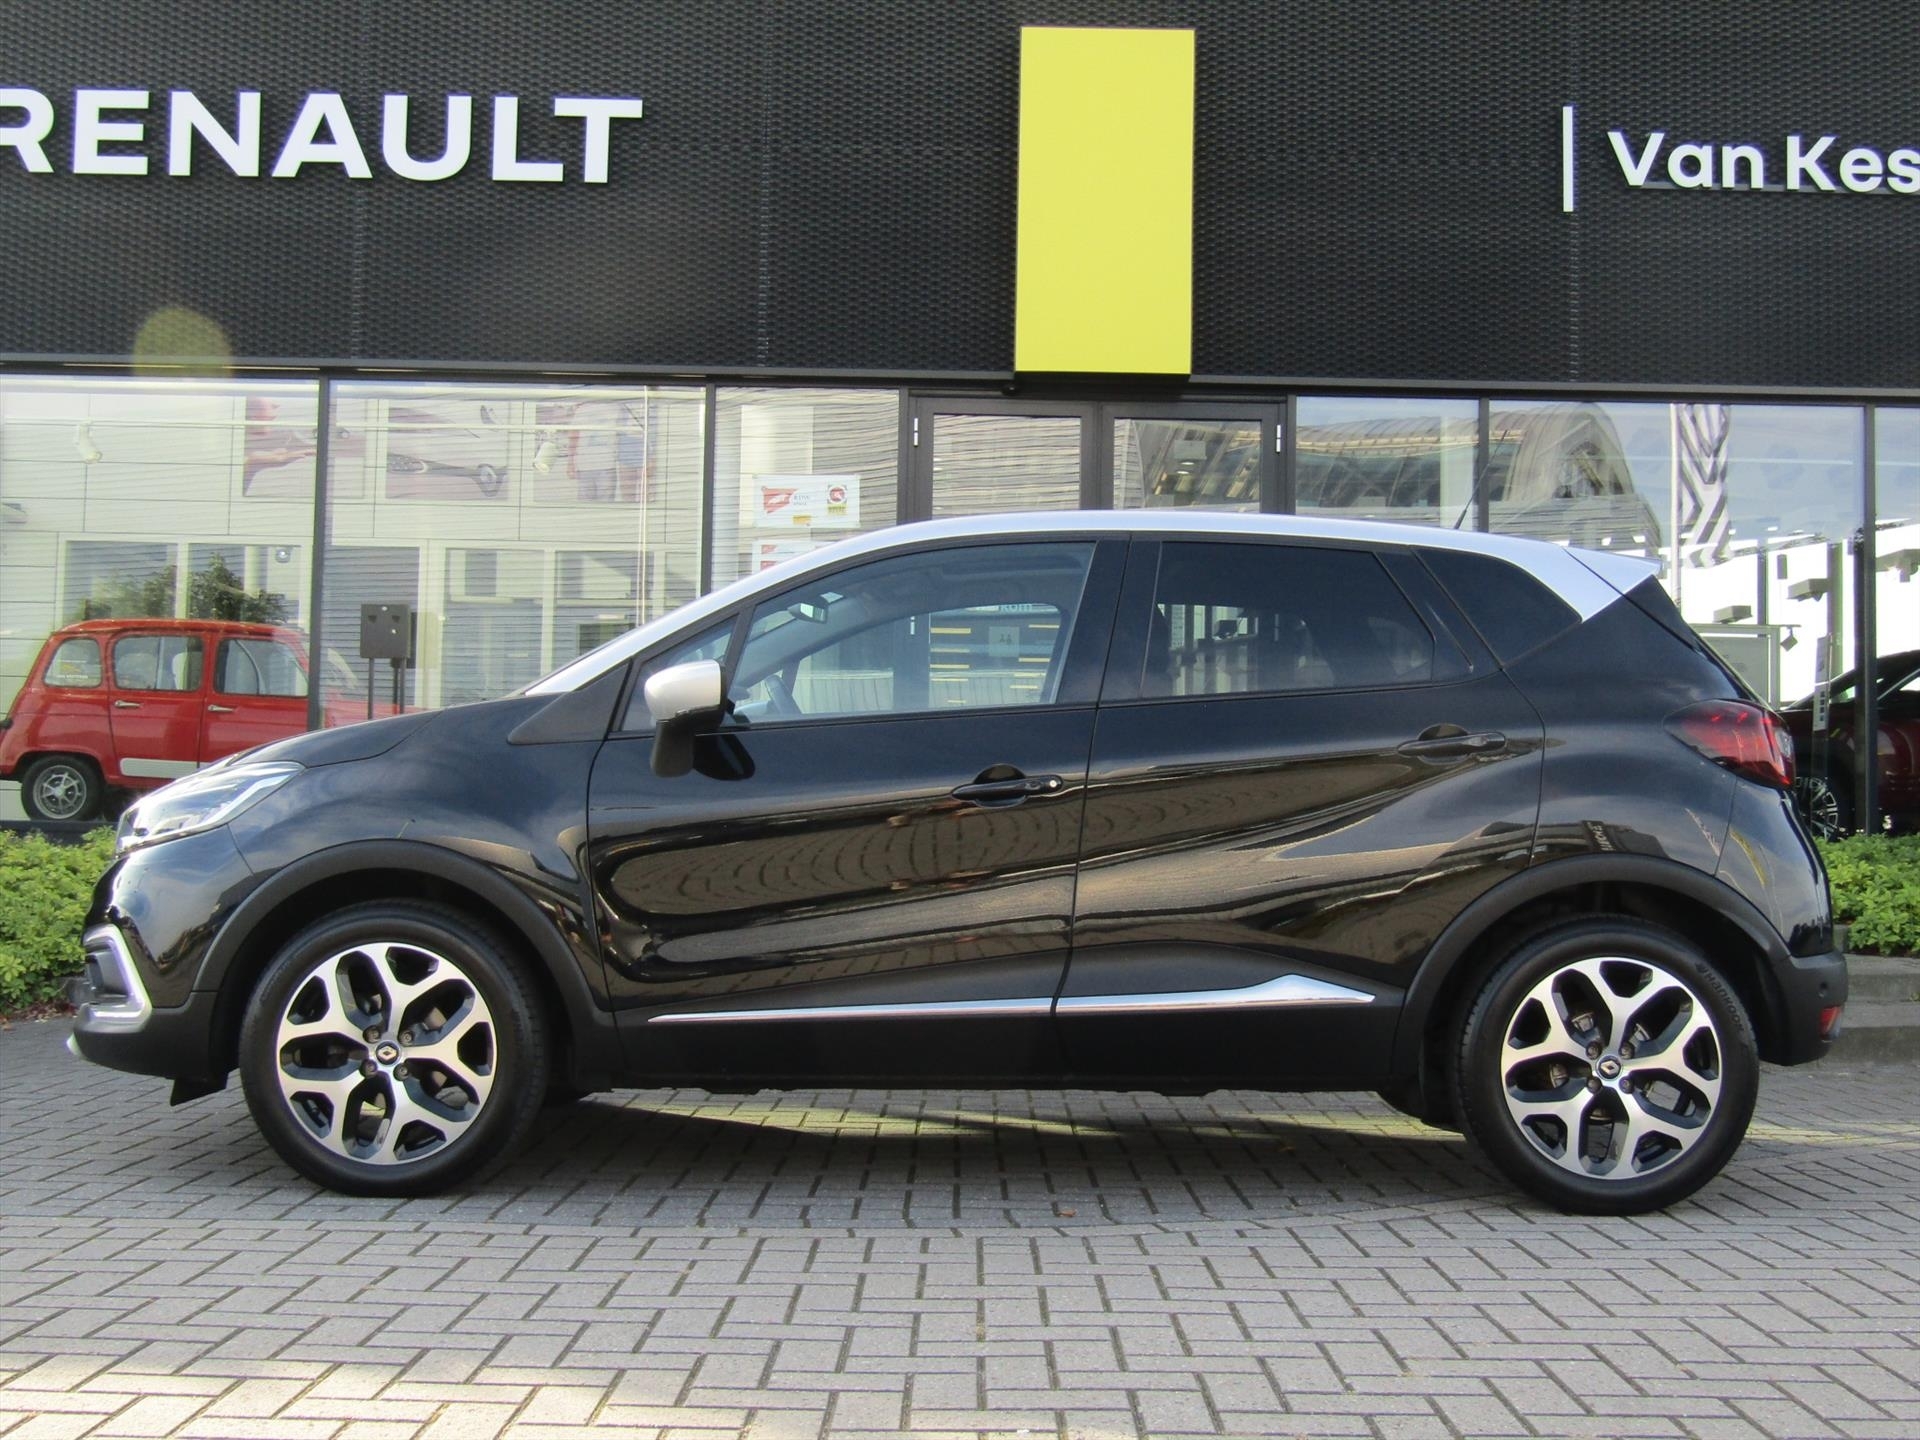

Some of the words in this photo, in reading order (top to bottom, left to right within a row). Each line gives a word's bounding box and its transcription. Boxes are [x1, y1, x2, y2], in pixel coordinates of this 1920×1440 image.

[0, 88, 643, 183] RENAULT
[1607, 131, 1764, 188] Van
[1786, 135, 1920, 194] Kes
